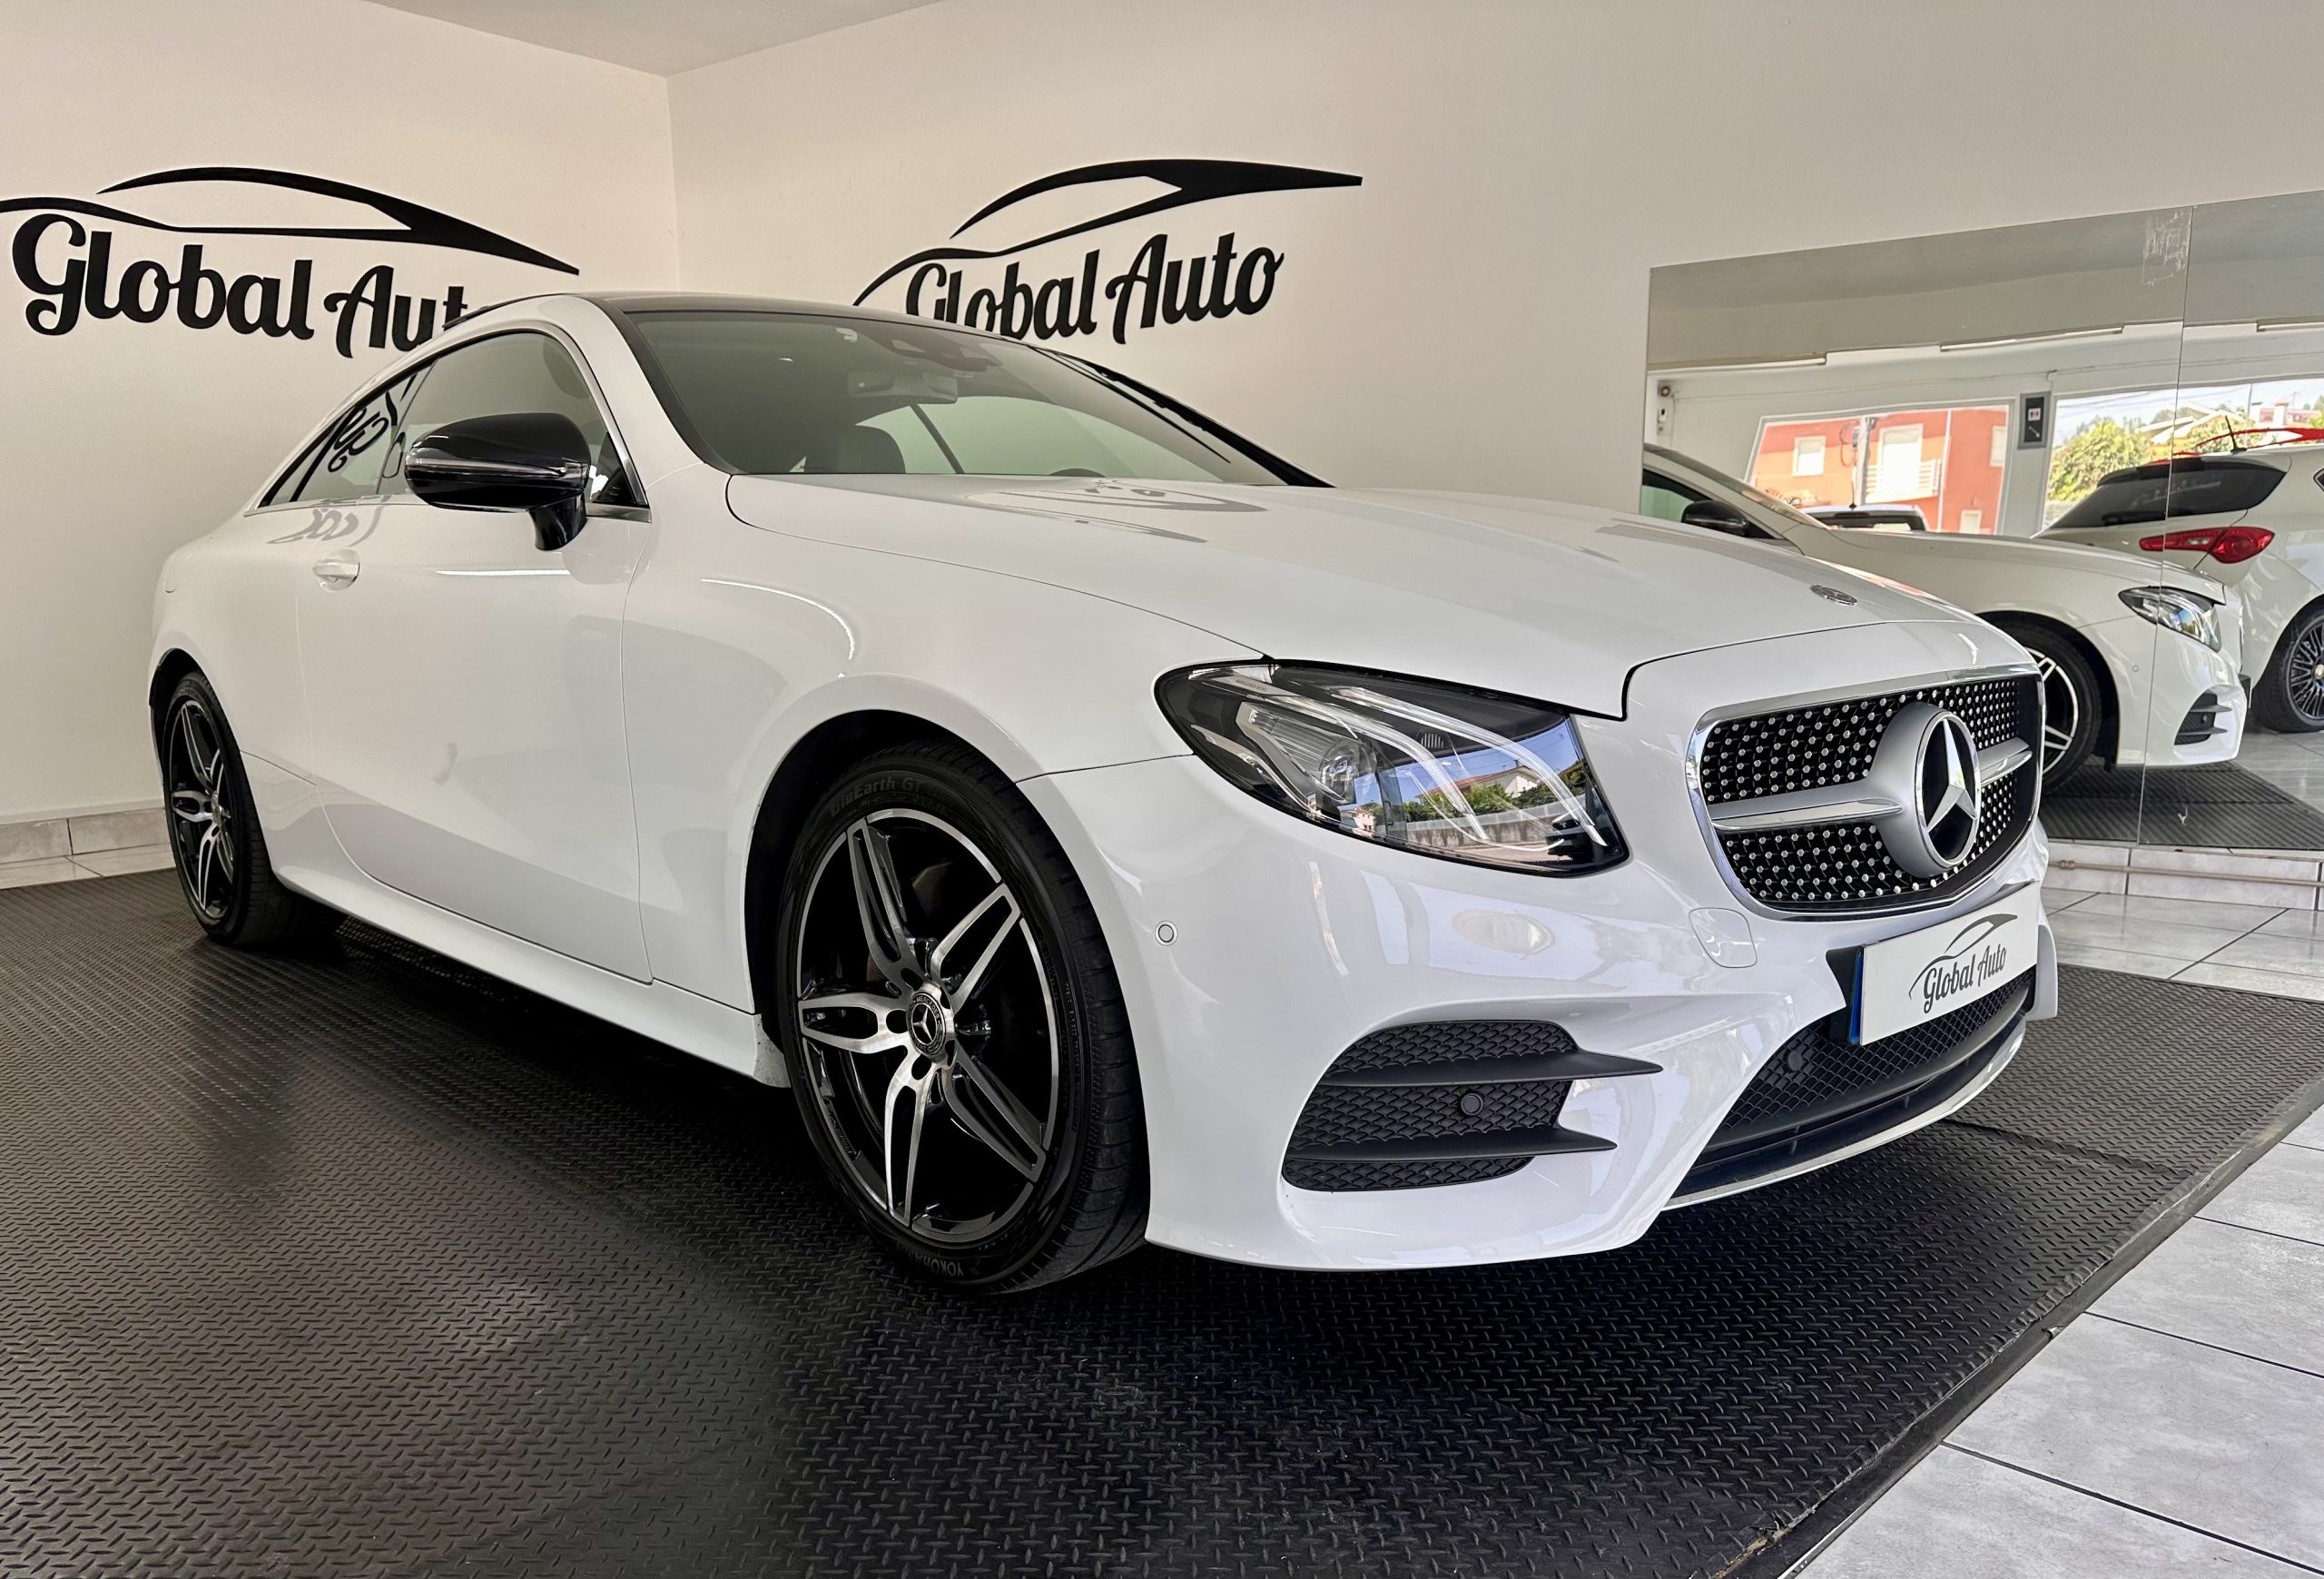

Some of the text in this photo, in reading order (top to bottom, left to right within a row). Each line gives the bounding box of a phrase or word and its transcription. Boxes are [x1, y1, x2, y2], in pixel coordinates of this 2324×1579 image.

[12, 212, 468, 359] Global Aut
[1105, 232, 1285, 345] Auto
[1924, 943, 2007, 1014] Global Auto
